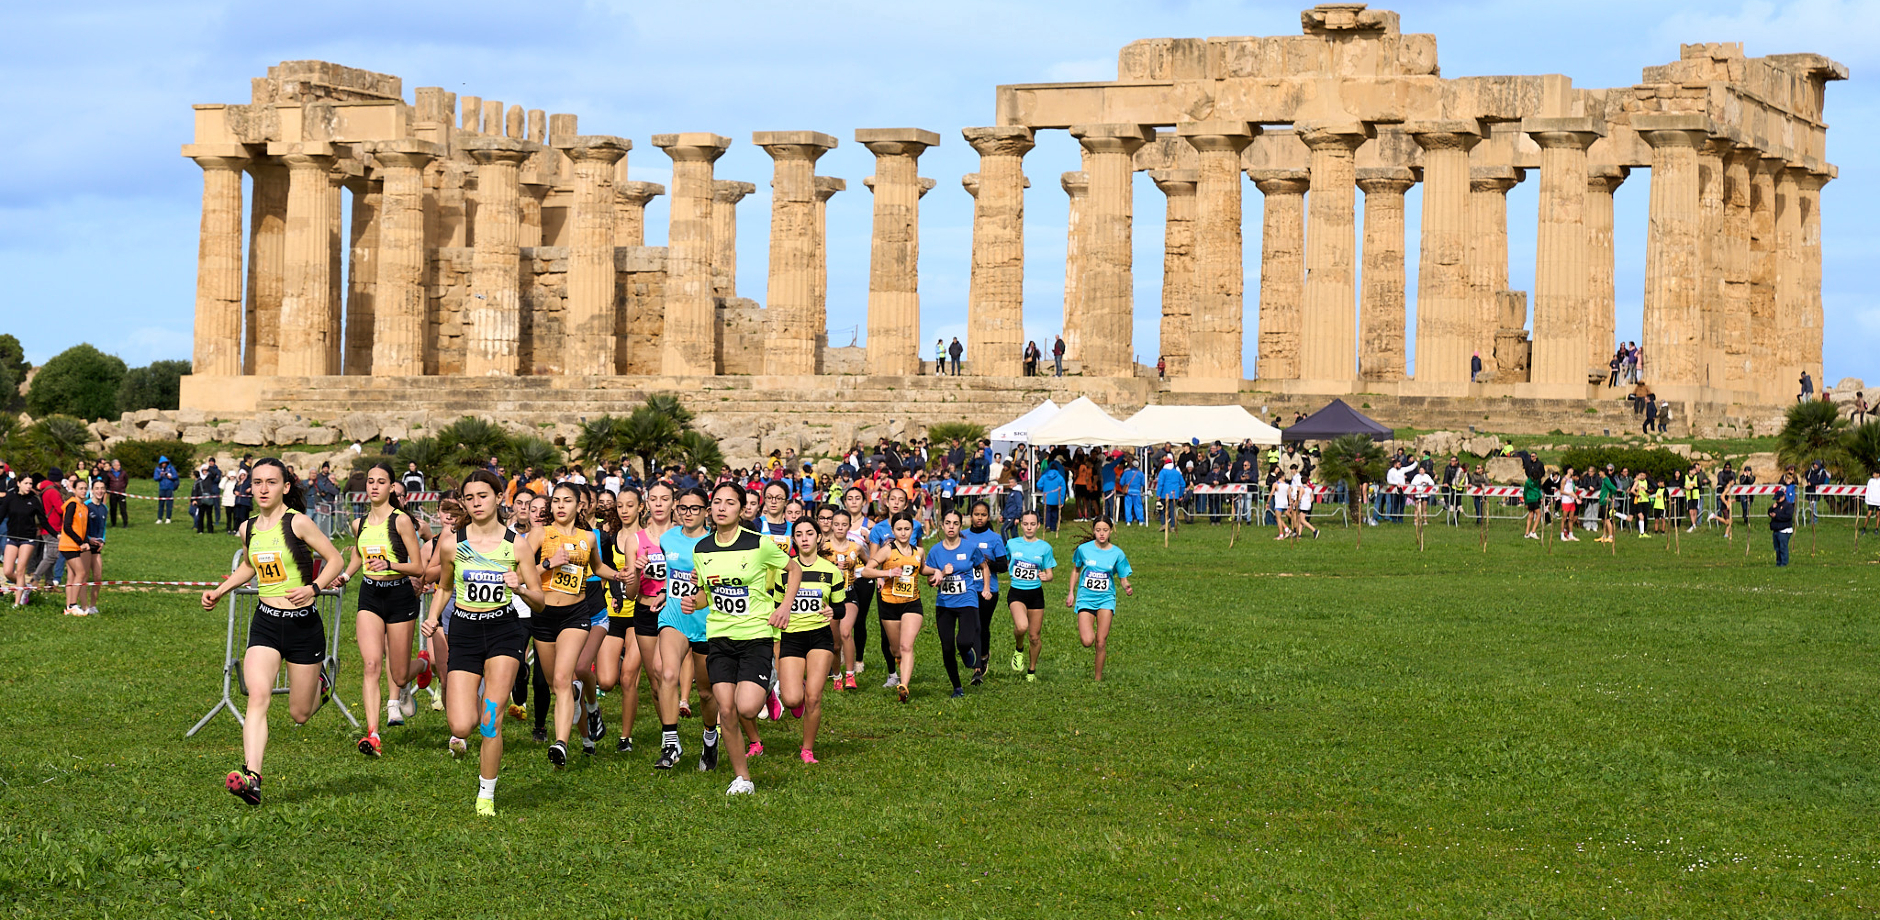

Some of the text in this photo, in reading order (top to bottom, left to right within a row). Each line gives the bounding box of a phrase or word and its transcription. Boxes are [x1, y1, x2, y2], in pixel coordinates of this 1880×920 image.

[258, 563, 281, 578] 141
[467, 571, 504, 582] Joma
[645, 563, 667, 578] 45
[673, 570, 691, 580] Jom
[1014, 567, 1036, 580] 825
[554, 572, 579, 588] 393
[1086, 579, 1108, 590] 823
[467, 583, 504, 602] 806
[713, 586, 745, 596] Joma
[895, 582, 912, 592] 392
[942, 581, 963, 593] 461
[258, 603, 309, 618] NIKE PRO
[714, 595, 747, 614] 809
[791, 598, 820, 612] 808
[454, 608, 503, 620] NIKE PRO
